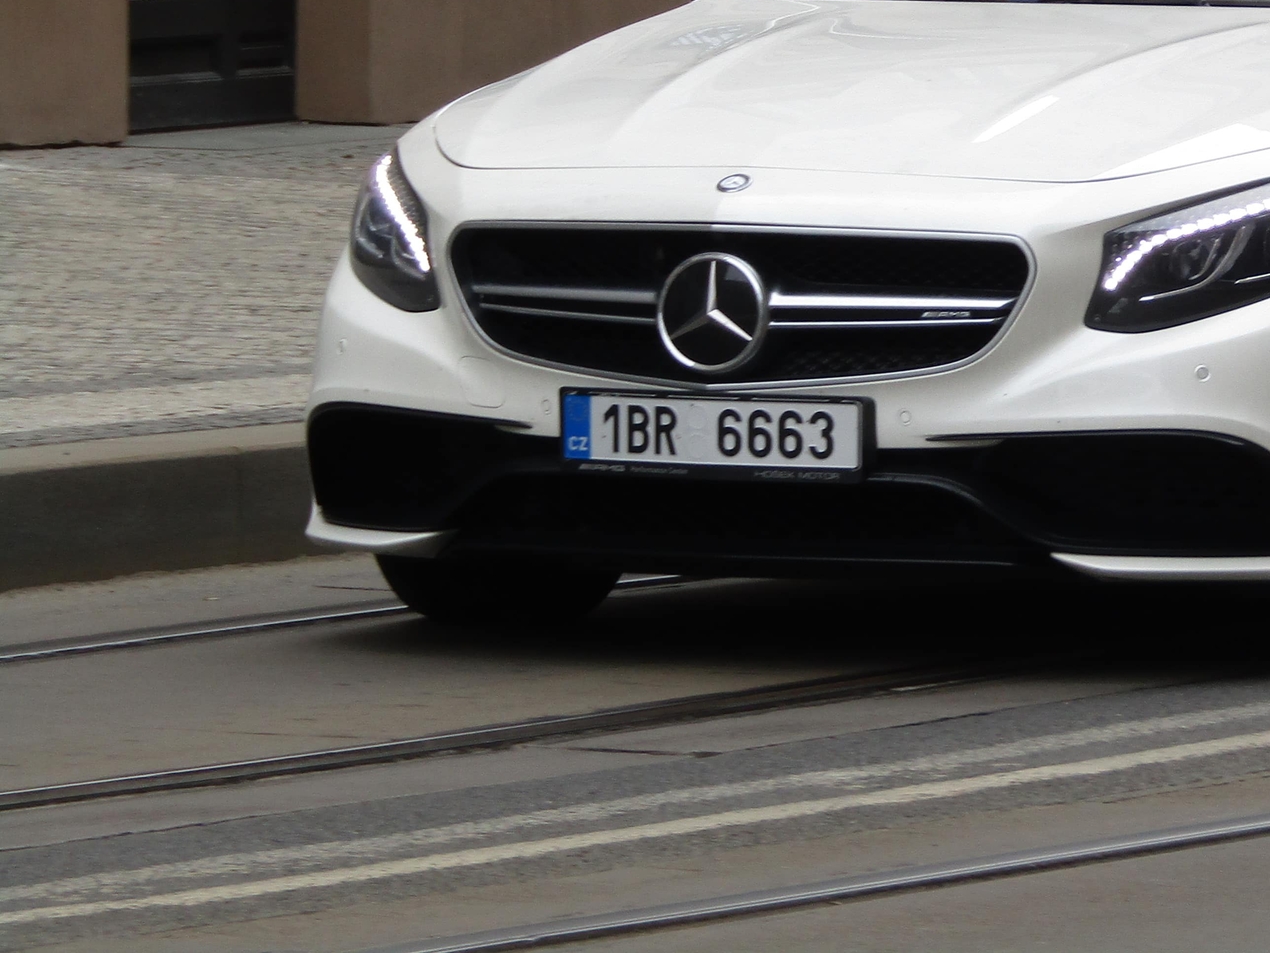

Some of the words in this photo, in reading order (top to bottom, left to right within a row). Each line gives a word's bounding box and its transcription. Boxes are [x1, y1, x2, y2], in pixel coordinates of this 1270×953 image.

[568, 436, 589, 451] CZ
[604, 404, 677, 456] 1BR
[717, 409, 834, 460] 6663
